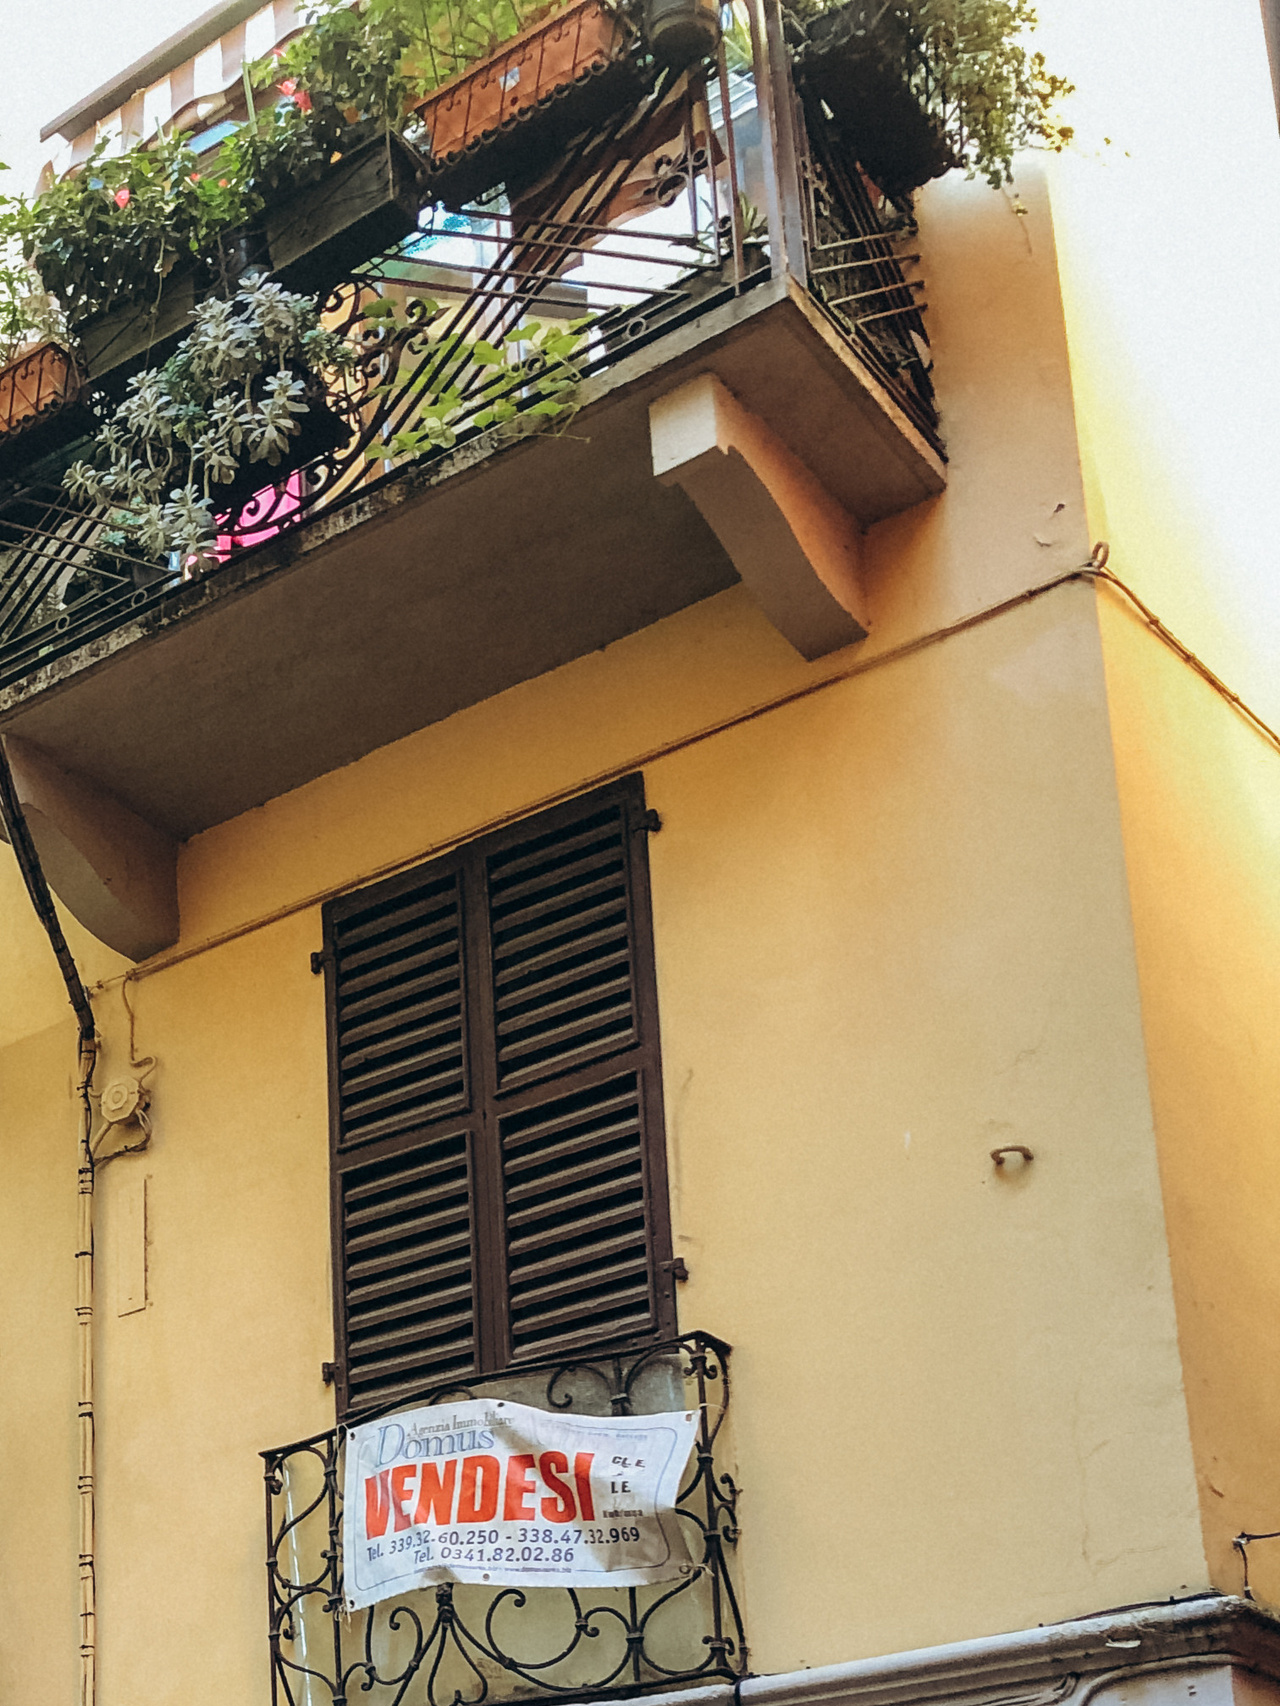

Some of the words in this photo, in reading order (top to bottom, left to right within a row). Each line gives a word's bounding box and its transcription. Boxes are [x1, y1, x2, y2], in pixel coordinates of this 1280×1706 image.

[376, 1422, 495, 1468] Domus
[365, 1450, 596, 1541] VENDESI
[367, 1543, 385, 1562] Tel.
[517, 1526, 641, 1546] 338.47.32.969
[414, 1546, 434, 1565] Tel.
[440, 1546, 575, 1564] 0341.82.02.86
